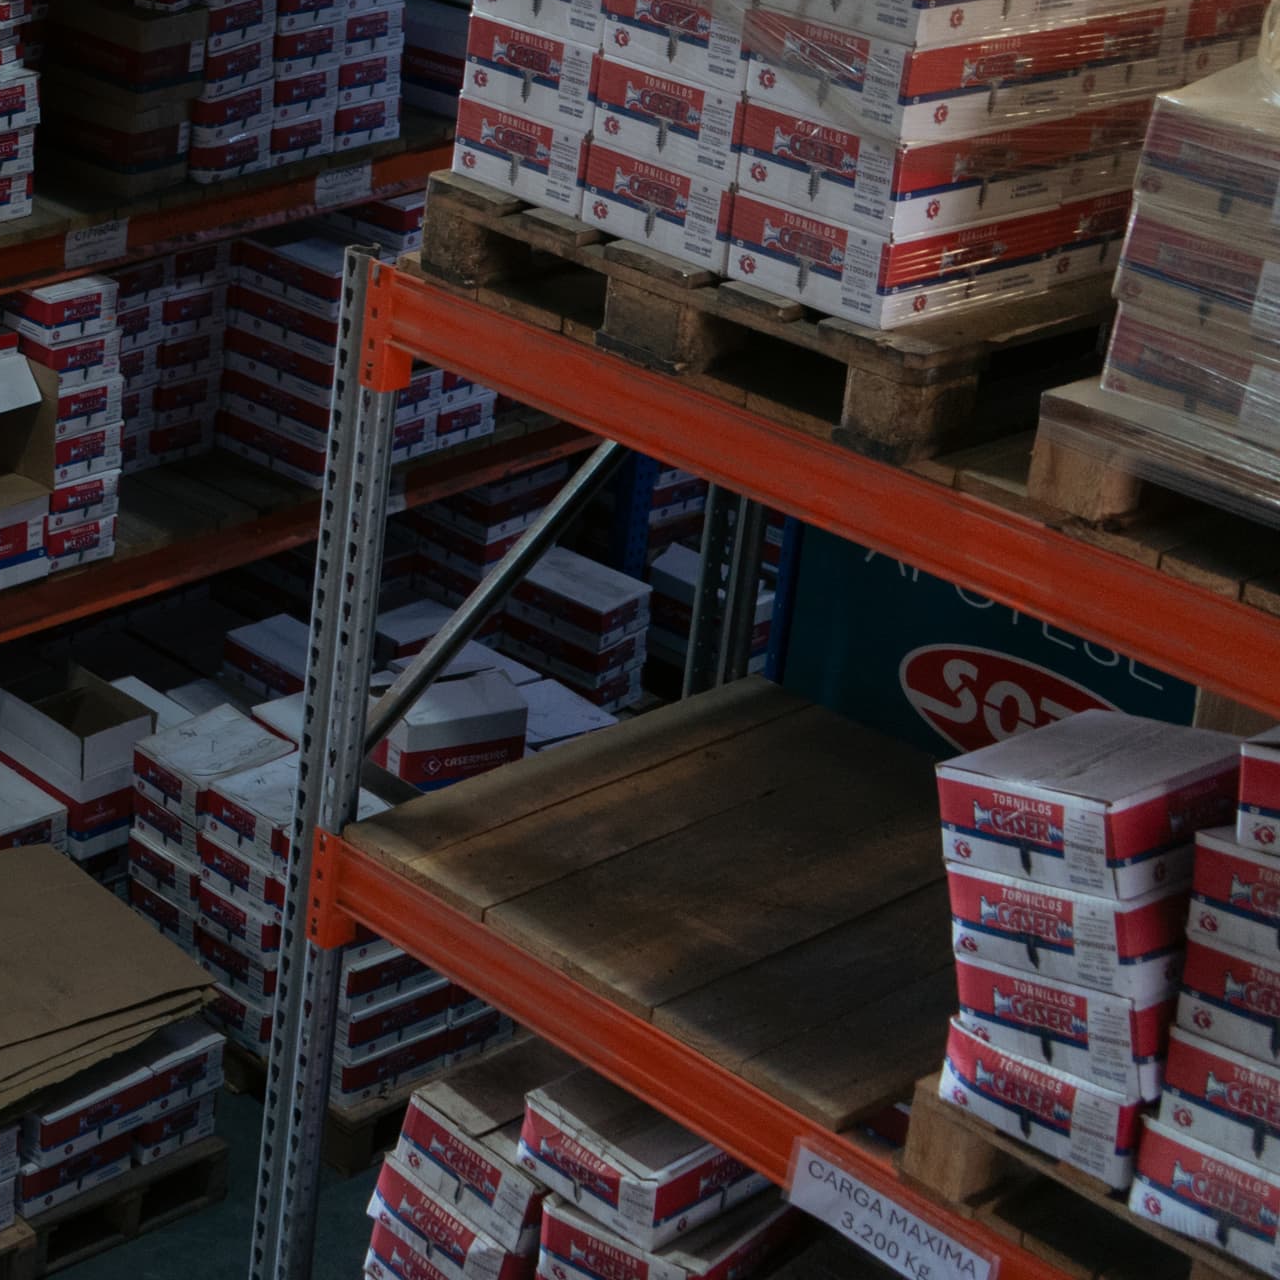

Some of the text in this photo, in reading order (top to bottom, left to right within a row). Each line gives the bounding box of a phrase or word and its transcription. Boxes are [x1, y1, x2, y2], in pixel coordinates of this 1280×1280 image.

[510, 30, 555, 52] TORNILLOS
[806, 24, 859, 47] TORNILLOS
[644, 77, 694, 99] TORNILLOS
[498, 112, 542, 136] TORNILLOS
[794, 120, 848, 146] TORNILLOS
[633, 161, 681, 187] TORNILLOS
[783, 212, 837, 240] TORNILLOS
[992, 792, 1052, 817] TORNILLOS
[991, 807, 1052, 845] CASER
[1001, 887, 1063, 913] TORNILLOS
[997, 902, 1061, 942] CASER
[1013, 980, 1076, 1008] TORNILLOS
[1010, 993, 1074, 1035] CASER
[993, 1069, 1056, 1120] CASER
[999, 1057, 1063, 1095] TORNILLOS
[448, 1134, 491, 1173] TORNILLOS
[560, 1134, 607, 1172] TORNILLOS
[1201, 1157, 1269, 1197] TORNILLOS
[419, 1196, 464, 1236] TORNILLOS
[1192, 1172, 1260, 1222] CASER
[808, 1160, 977, 1279] CARGA MAXIMA
[588, 1237, 638, 1268] TORNILLOS
[841, 1211, 932, 1280] 3.200 Kg
